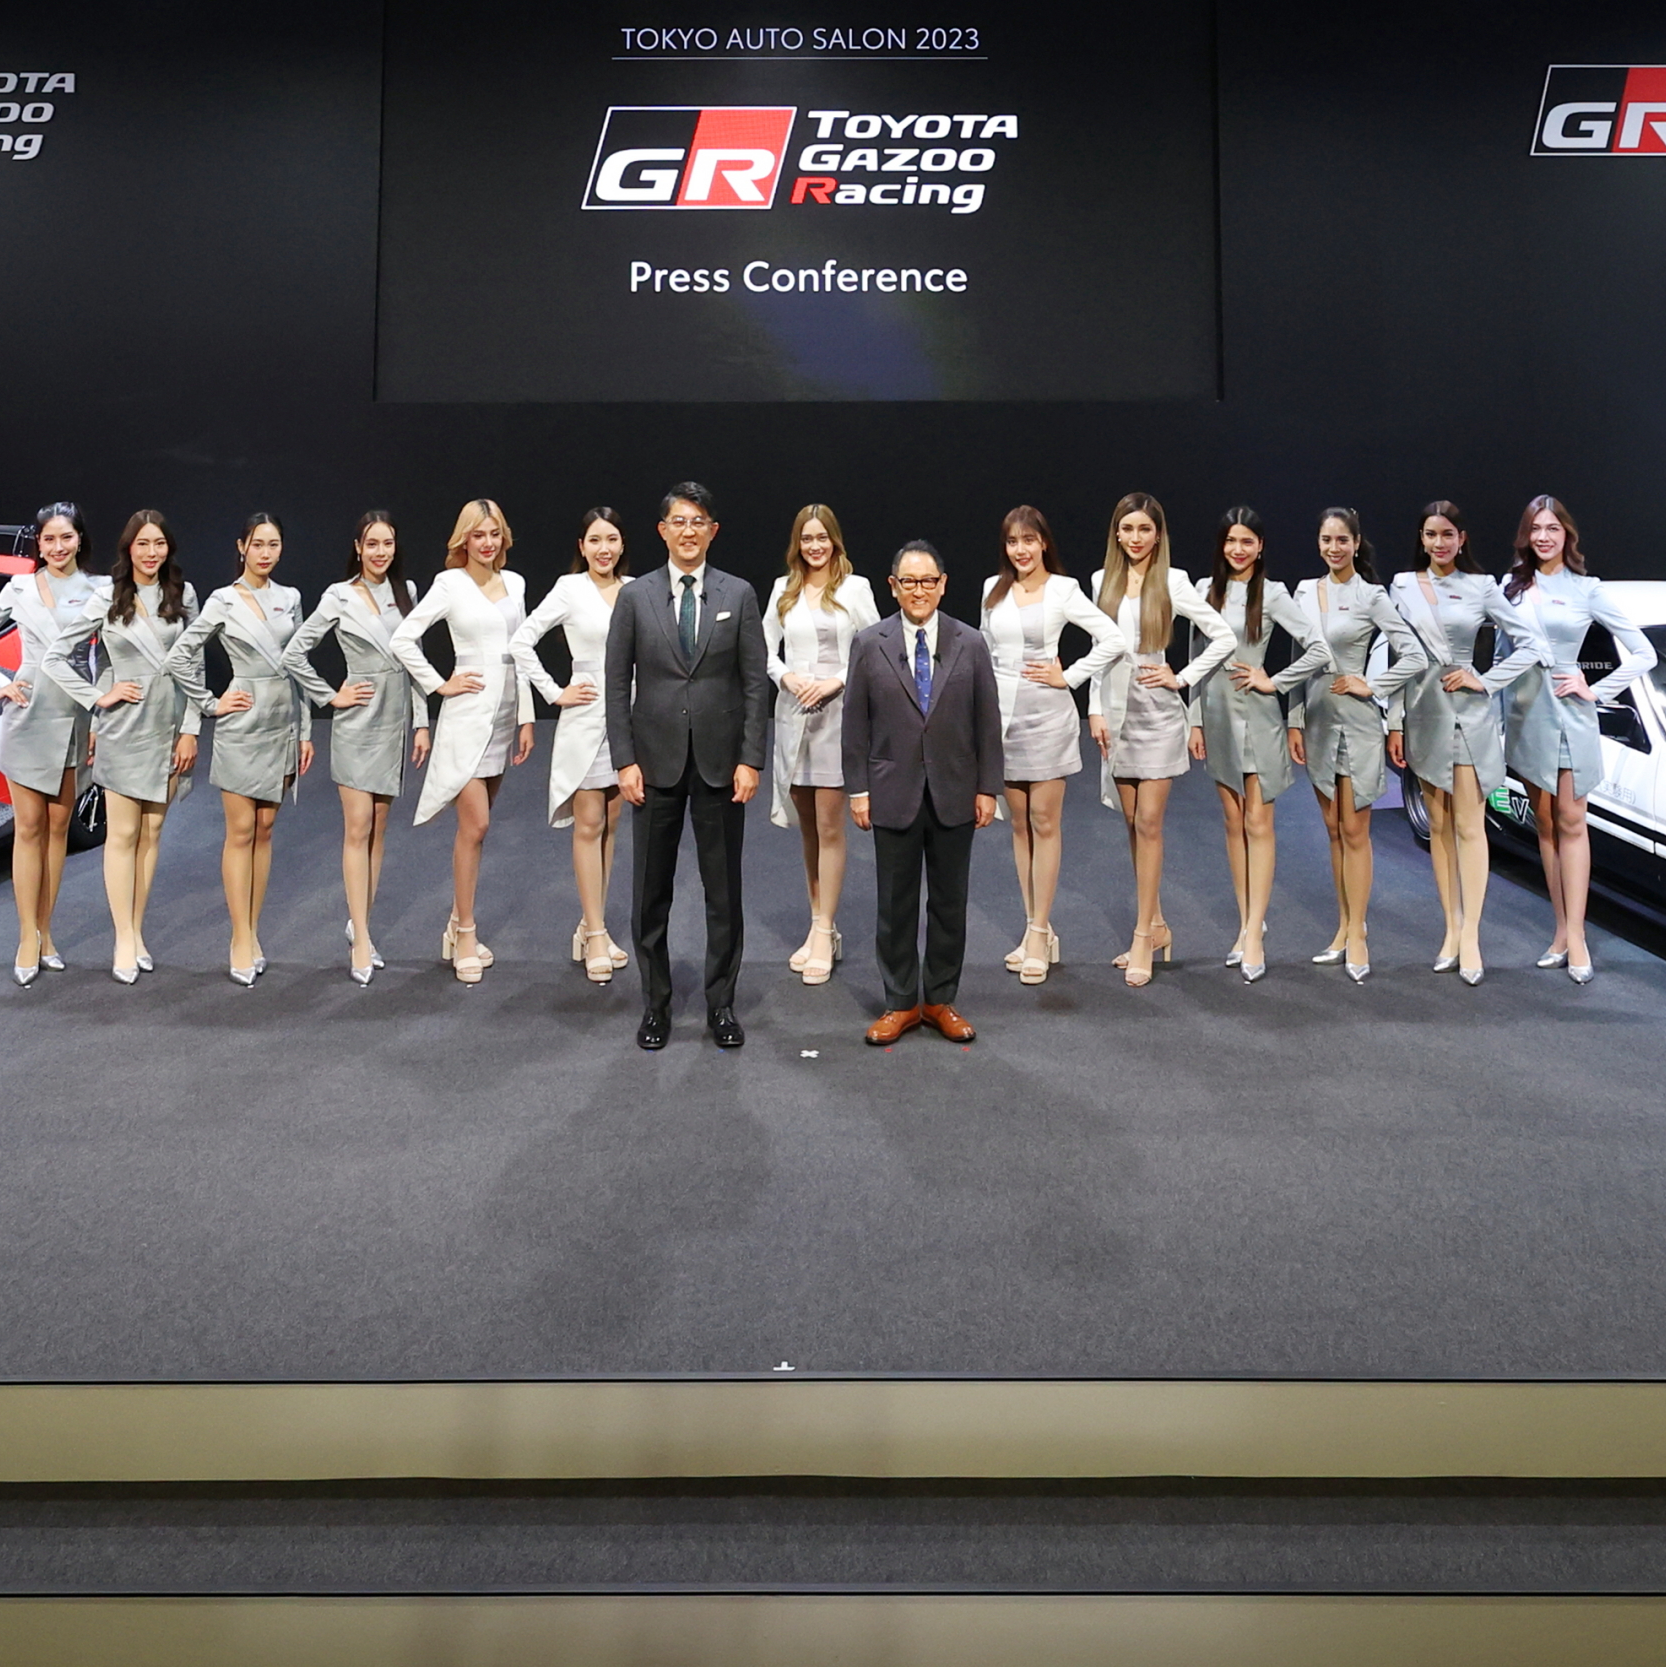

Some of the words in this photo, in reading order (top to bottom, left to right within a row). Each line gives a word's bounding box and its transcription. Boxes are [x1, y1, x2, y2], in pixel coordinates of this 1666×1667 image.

[621, 28, 718, 51] TOKYO
[726, 28, 804, 51] AUTO
[812, 28, 907, 51] SALON
[916, 28, 981, 51] 2023
[808, 109, 1020, 139] TOYOTA
[798, 142, 996, 172] GAZOO
[595, 147, 777, 201] GR
[790, 176, 986, 215] Racing
[629, 260, 731, 293] Press
[743, 259, 968, 293] Conference
